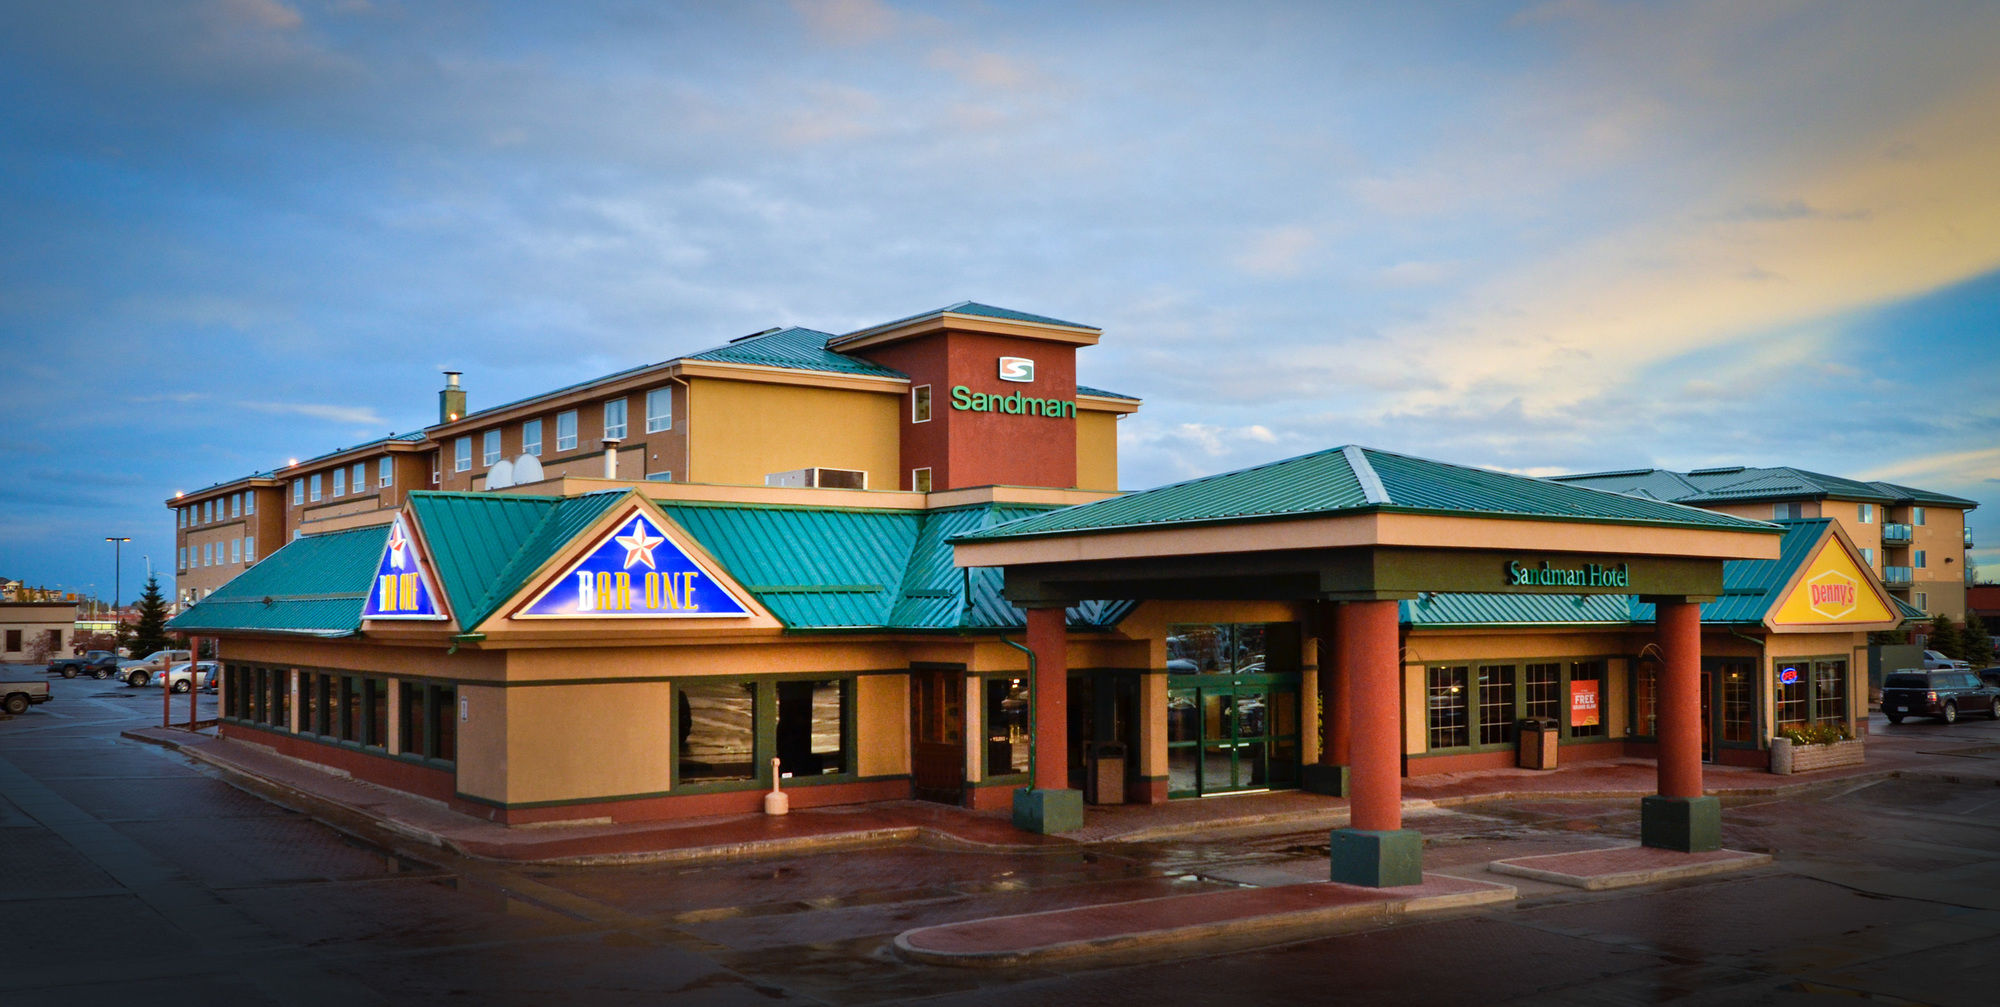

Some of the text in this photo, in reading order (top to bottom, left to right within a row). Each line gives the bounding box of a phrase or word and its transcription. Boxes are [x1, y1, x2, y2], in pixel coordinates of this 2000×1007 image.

[952, 385, 1076, 418] Sandman
[1511, 560, 1630, 587] Sandman Hotel
[576, 571, 699, 611] BAR ONE
[1811, 580, 1854, 607] Denny's
[1575, 694, 1595, 704] FREE
